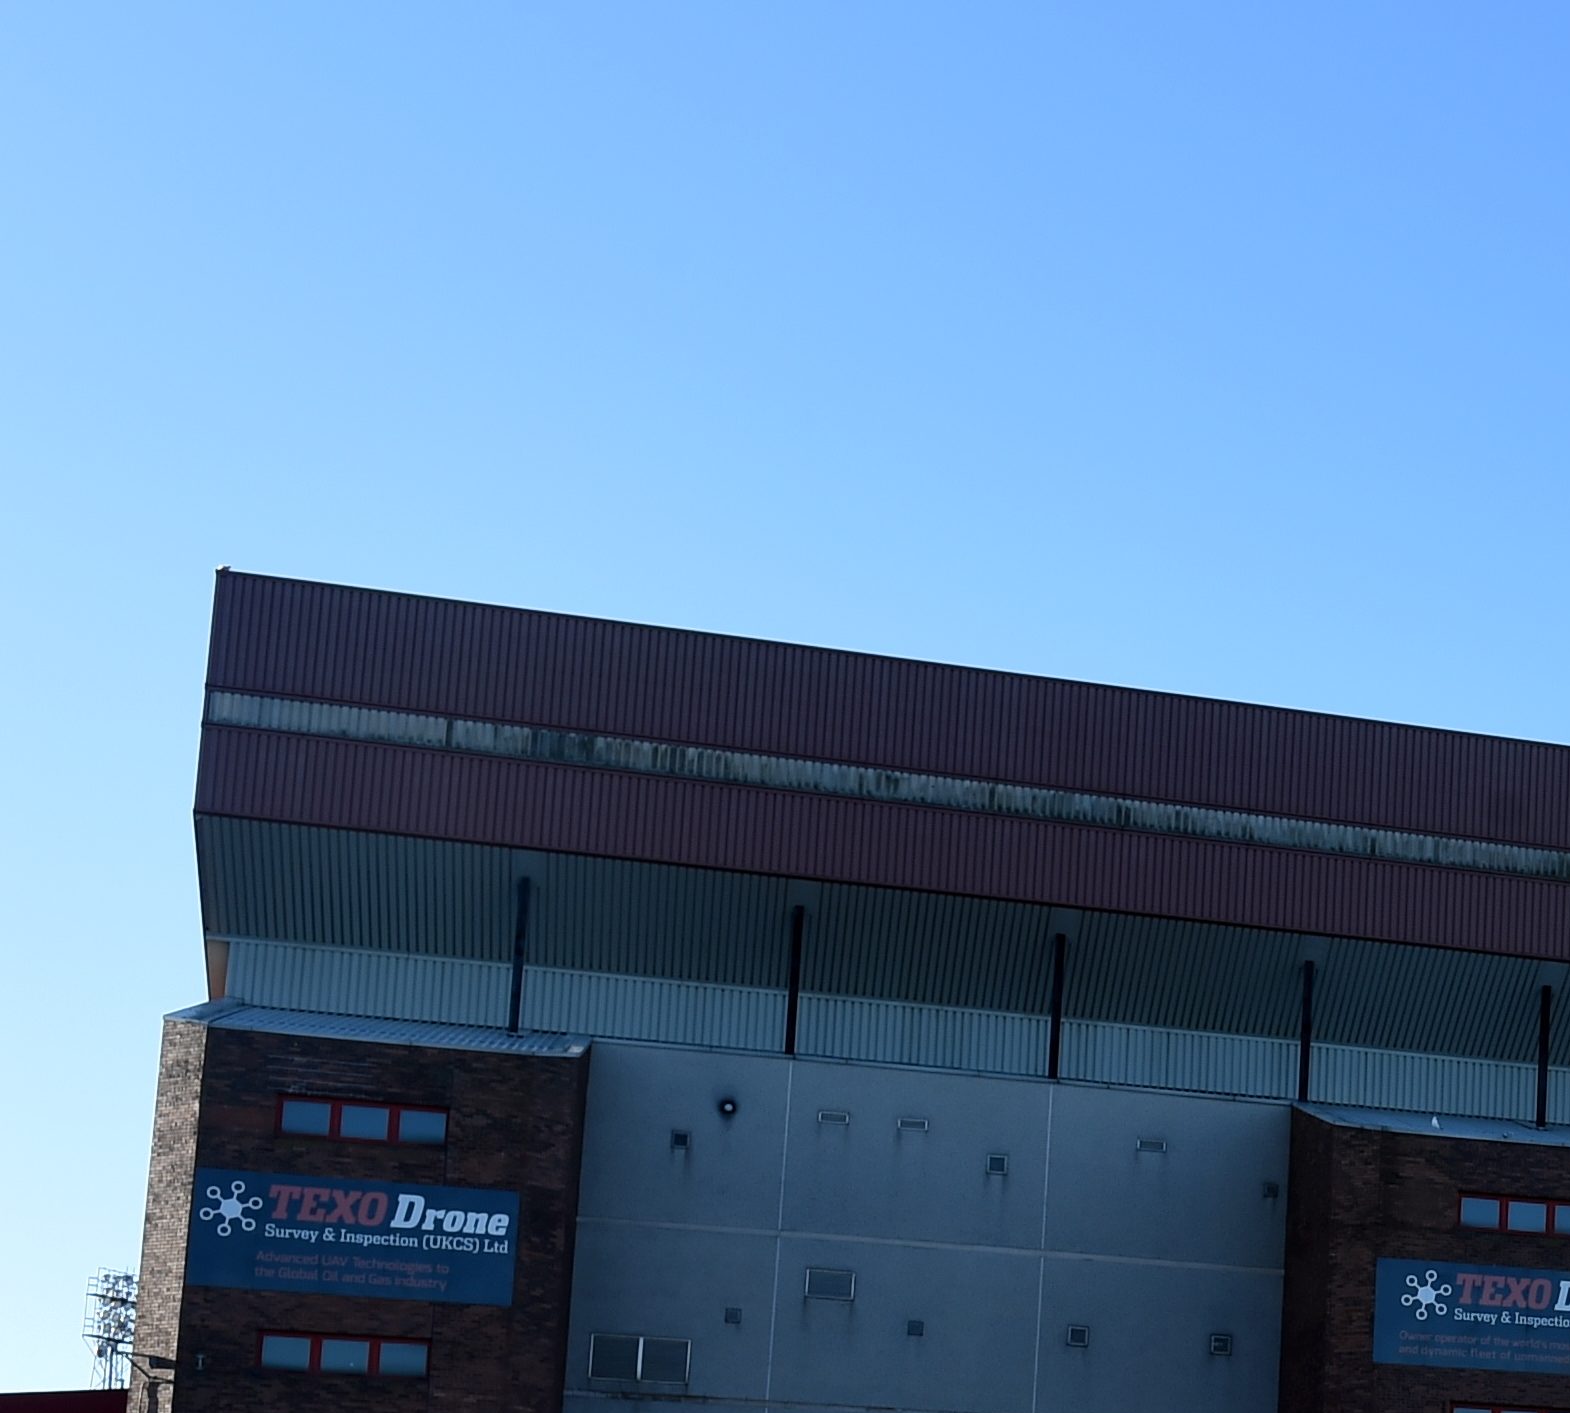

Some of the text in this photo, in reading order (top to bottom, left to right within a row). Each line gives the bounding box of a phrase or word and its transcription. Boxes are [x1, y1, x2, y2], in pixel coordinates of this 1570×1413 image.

[268, 1184, 510, 1236] TEXO Drone
[264, 1223, 509, 1254] Survey & Inspection (UKCS) Ltd
[254, 1266, 275, 1277] the
[278, 1267, 318, 1281] Global
[321, 1269, 339, 1282] Oil
[342, 1273, 366, 1285] and
[368, 1274, 392, 1286] Gas
[256, 1251, 449, 1275] Advanced UAV Technologies to
[1456, 1272, 1553, 1310] TEXO
[1454, 1308, 1498, 1326] Survey
[1501, 1312, 1512, 1324] &
